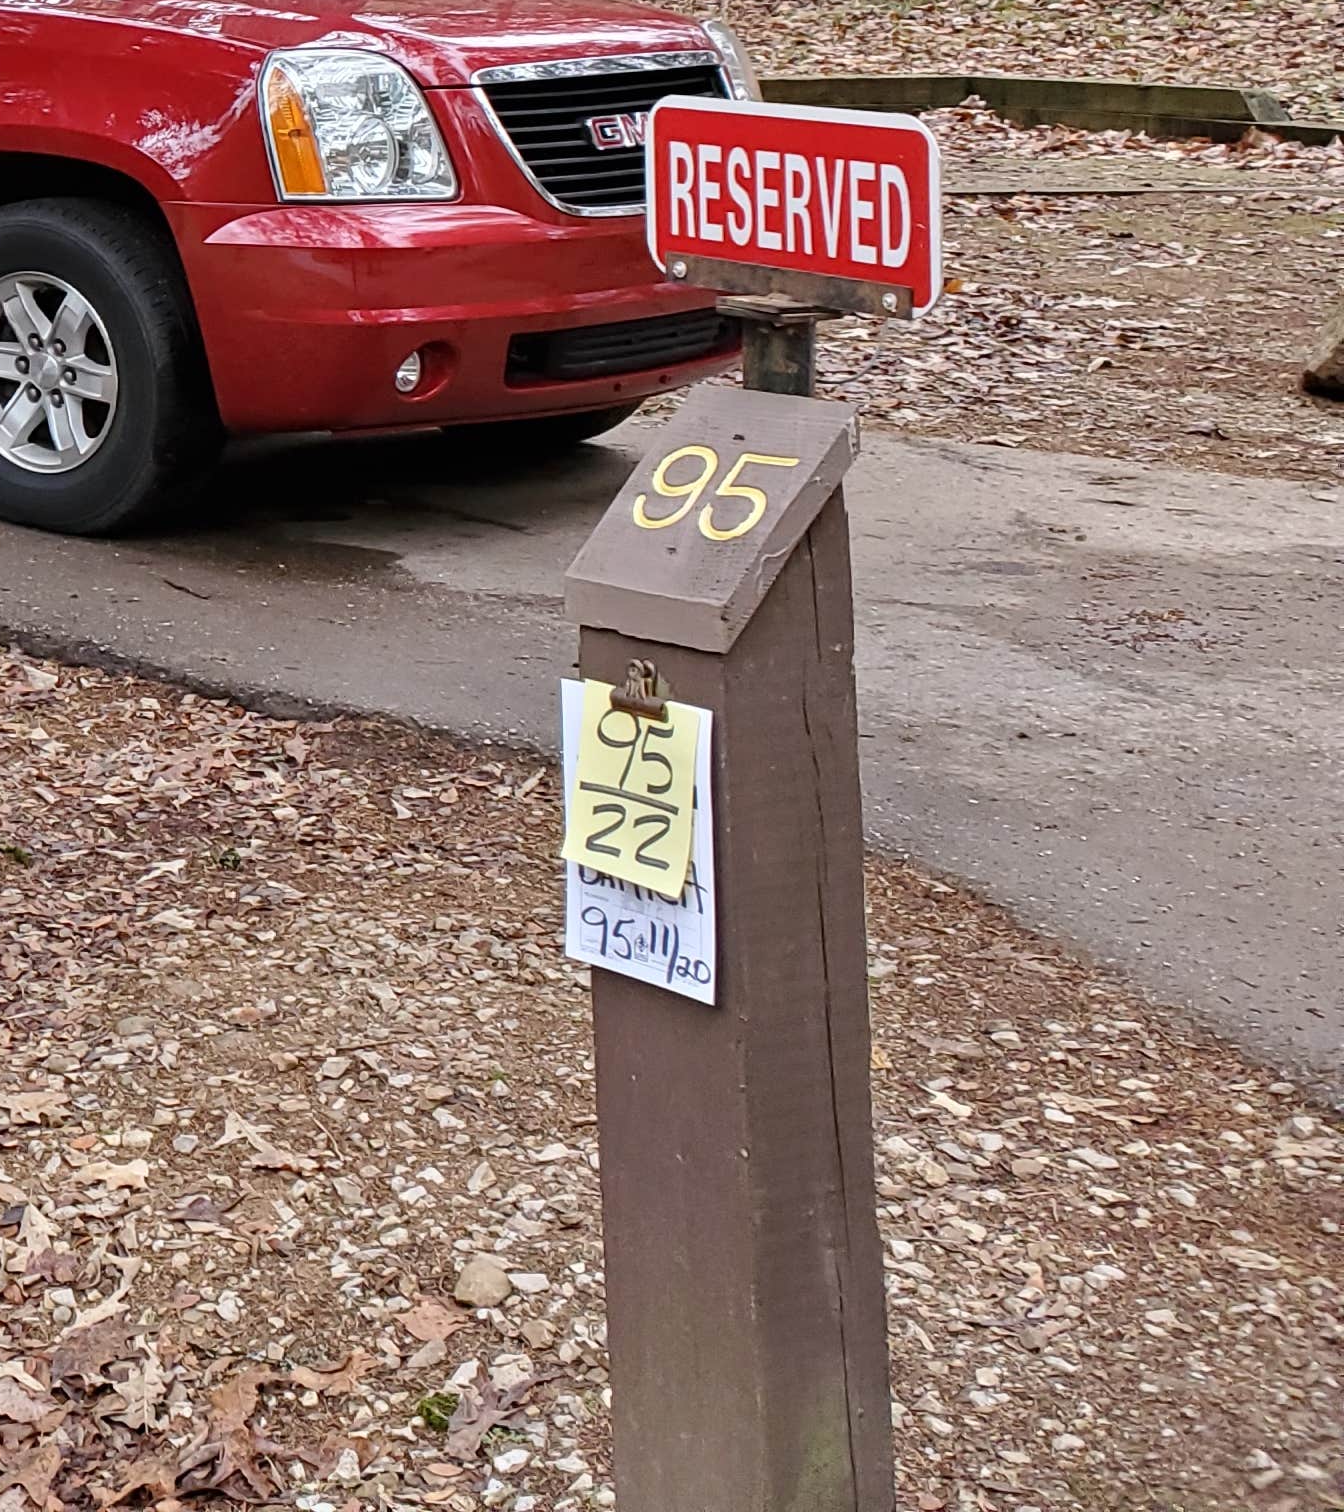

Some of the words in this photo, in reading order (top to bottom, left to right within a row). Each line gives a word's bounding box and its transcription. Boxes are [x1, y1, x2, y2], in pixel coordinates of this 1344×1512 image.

[585, 111, 650, 150] GM
[668, 140, 911, 268] RESERVED
[632, 445, 801, 541] 95
[597, 708, 675, 794] 95
[585, 803, 671, 871] 22
